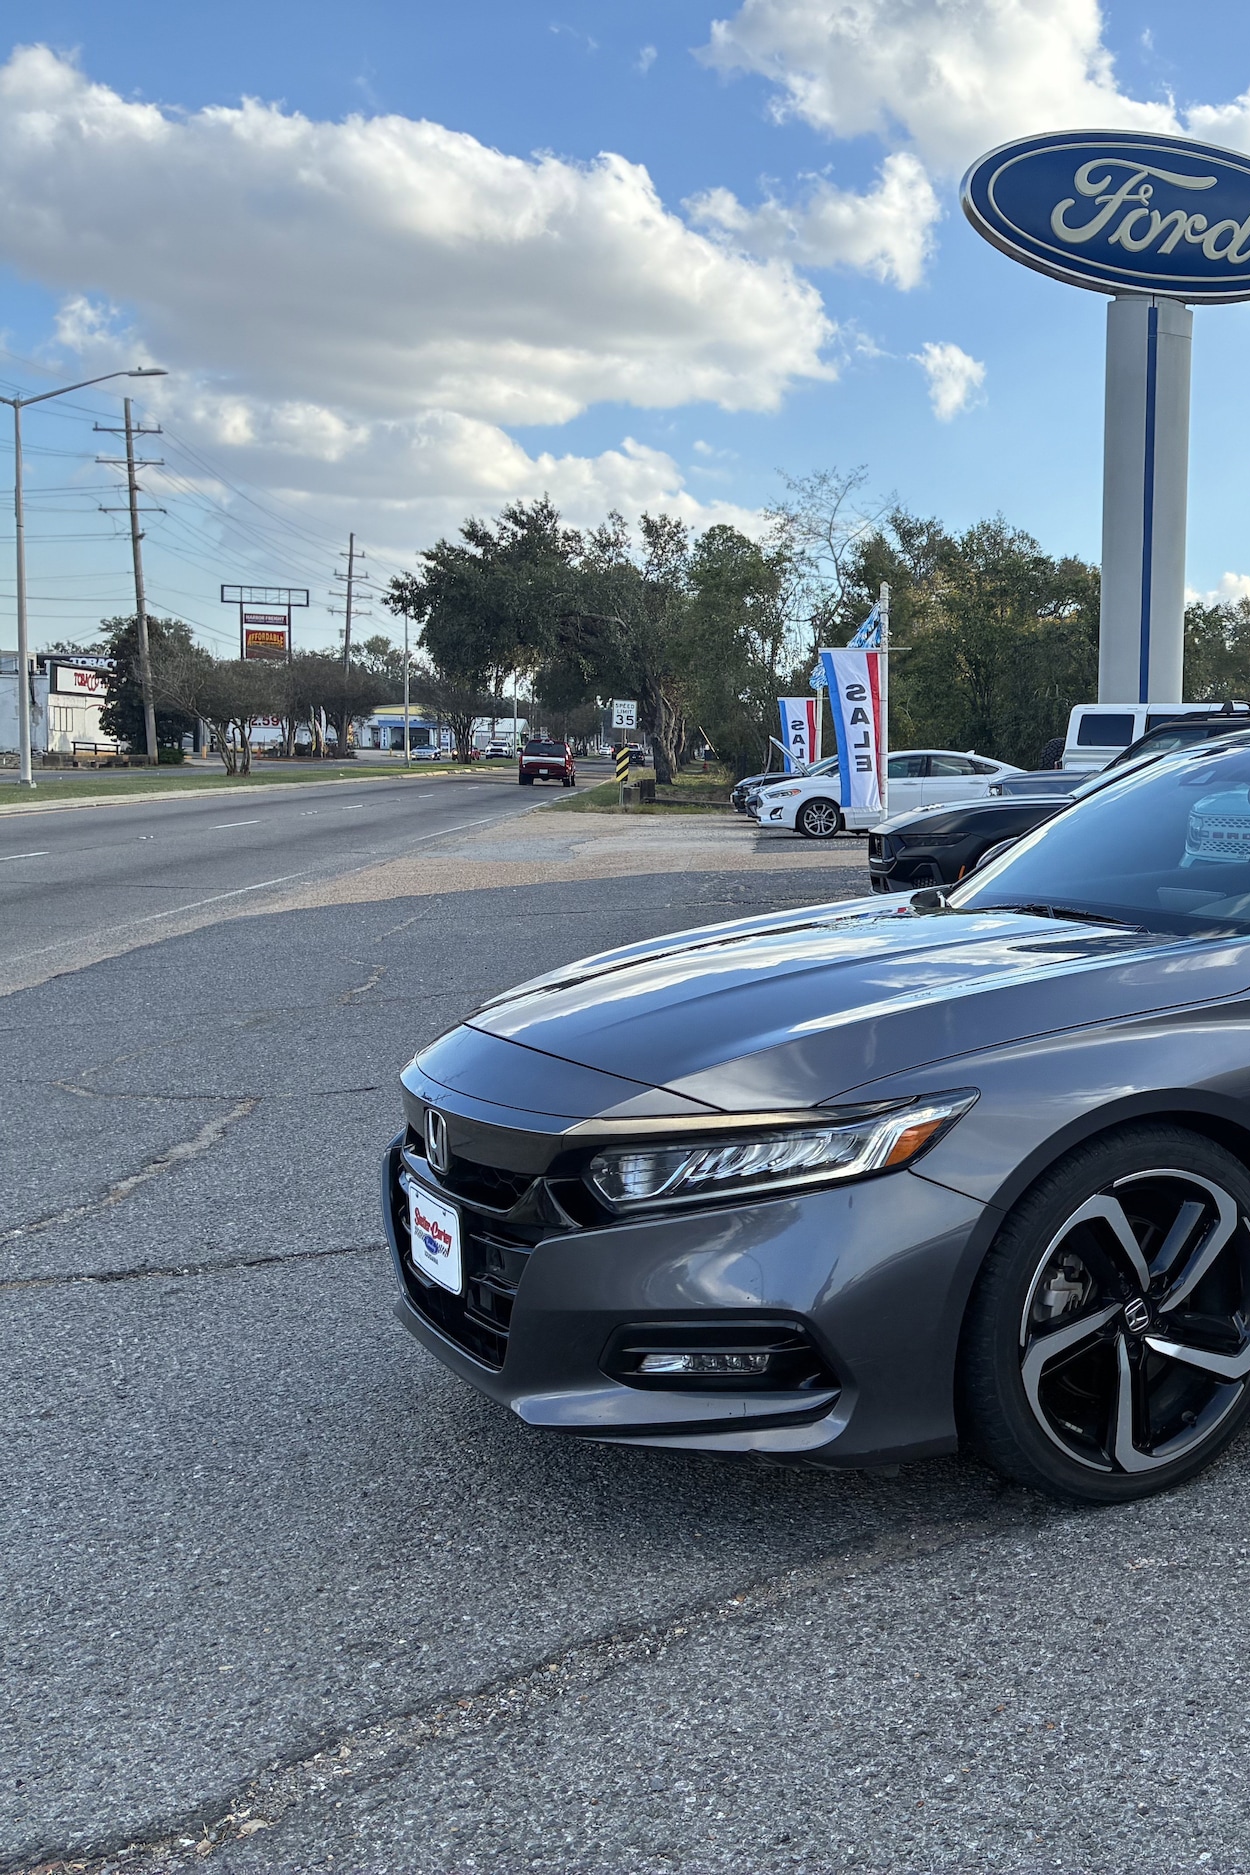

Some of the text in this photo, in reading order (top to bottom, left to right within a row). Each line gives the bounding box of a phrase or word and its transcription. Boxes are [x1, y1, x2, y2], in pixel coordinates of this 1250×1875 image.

[247, 632, 284, 648] AFFORDABLE
[69, 657, 117, 671] TOBAC
[615, 714, 635, 726] 35
